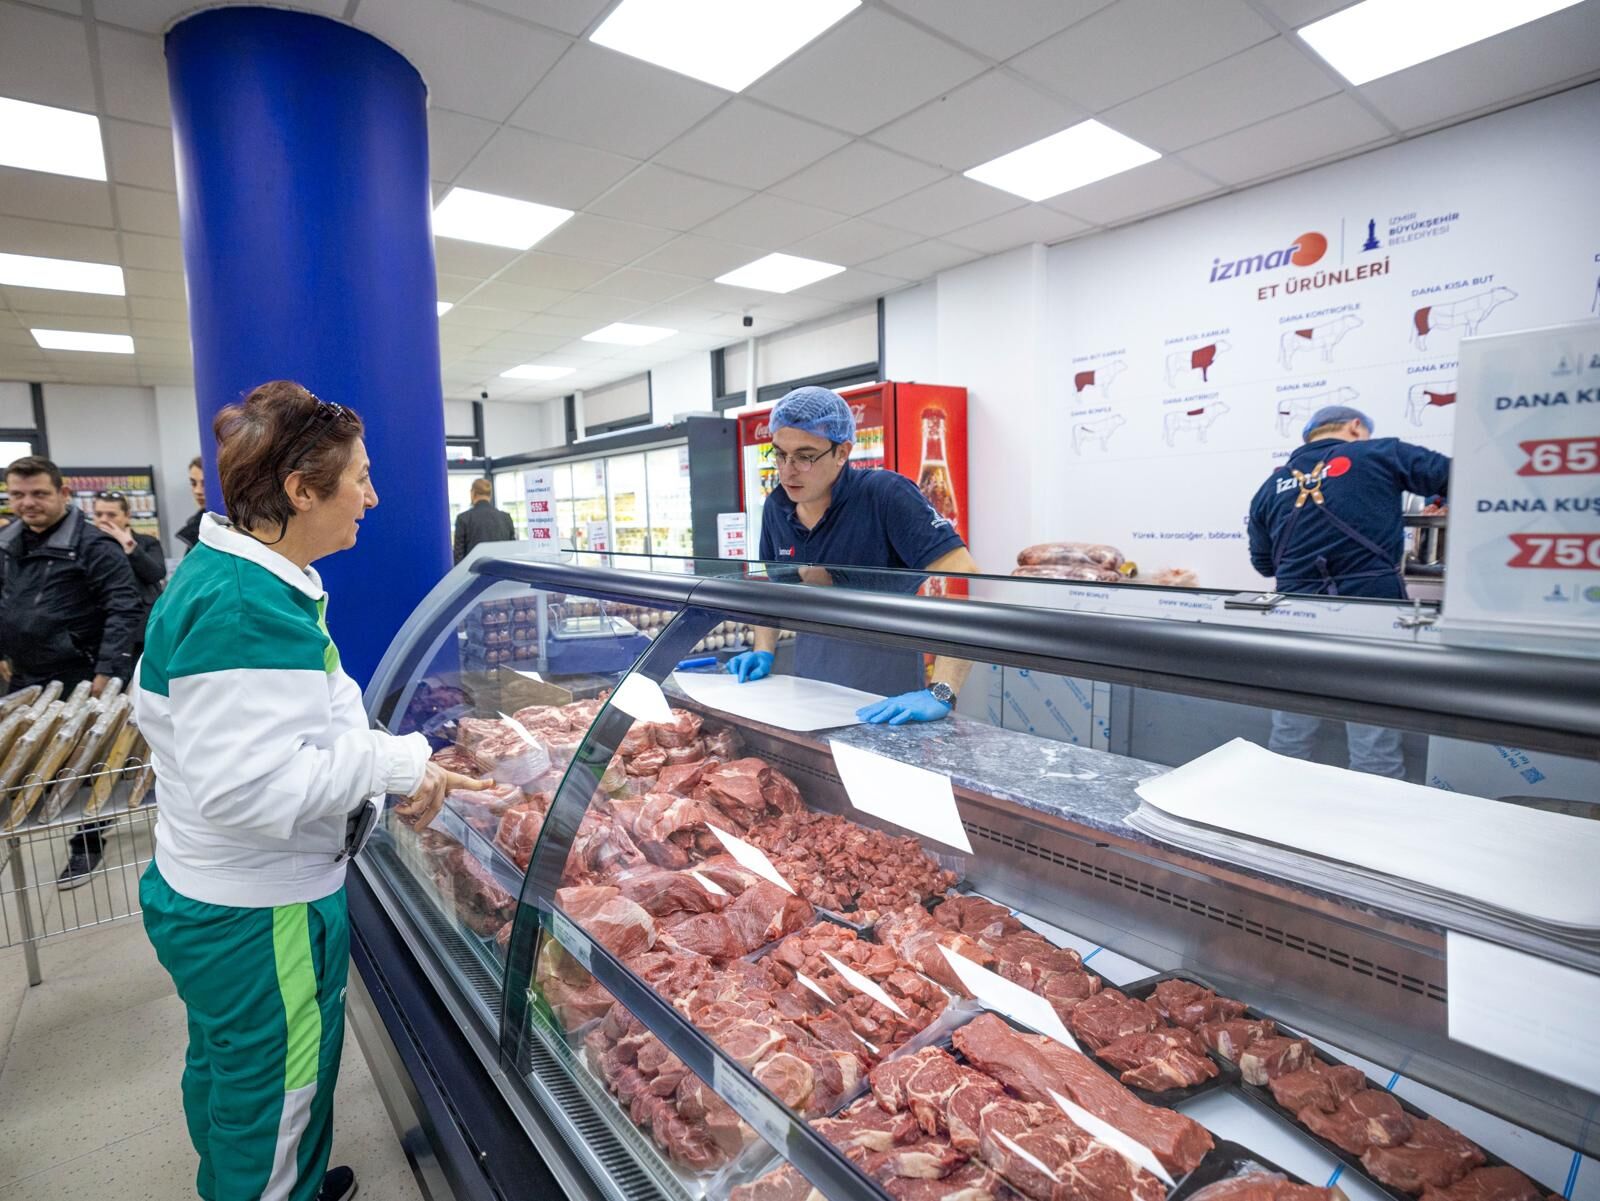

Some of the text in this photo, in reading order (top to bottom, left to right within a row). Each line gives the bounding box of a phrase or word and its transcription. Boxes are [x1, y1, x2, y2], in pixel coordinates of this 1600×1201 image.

[1389, 212, 1459, 236] BÜYÜKŞEHİR
[1209, 243, 1302, 283] izmar
[1257, 256, 1390, 300] ET ÜRÜNLERİ
[1412, 274, 1495, 297] DANA KISA BUT
[1279, 312, 1303, 324] DANA
[1408, 364, 1437, 374] DANA
[1495, 391, 1570, 411] DANA
[1276, 465, 1332, 494] izr
[1477, 498, 1547, 513] DANA
